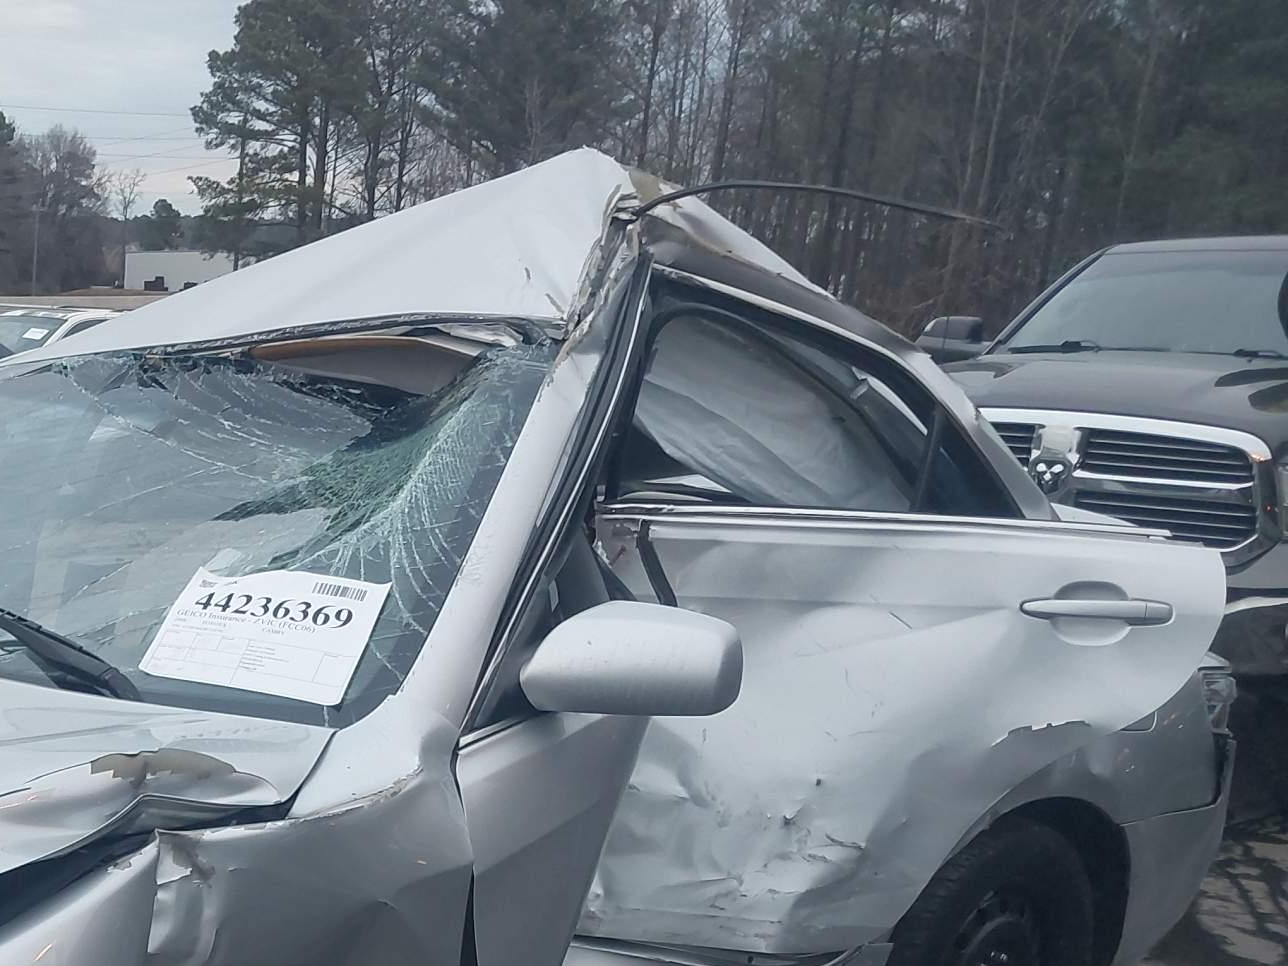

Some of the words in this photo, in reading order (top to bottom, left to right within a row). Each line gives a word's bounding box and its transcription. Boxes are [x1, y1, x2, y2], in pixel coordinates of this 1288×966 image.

[176, 608, 207, 619] GEICO
[208, 612, 248, 623] Insurance
[194, 591, 354, 629] 44236369
